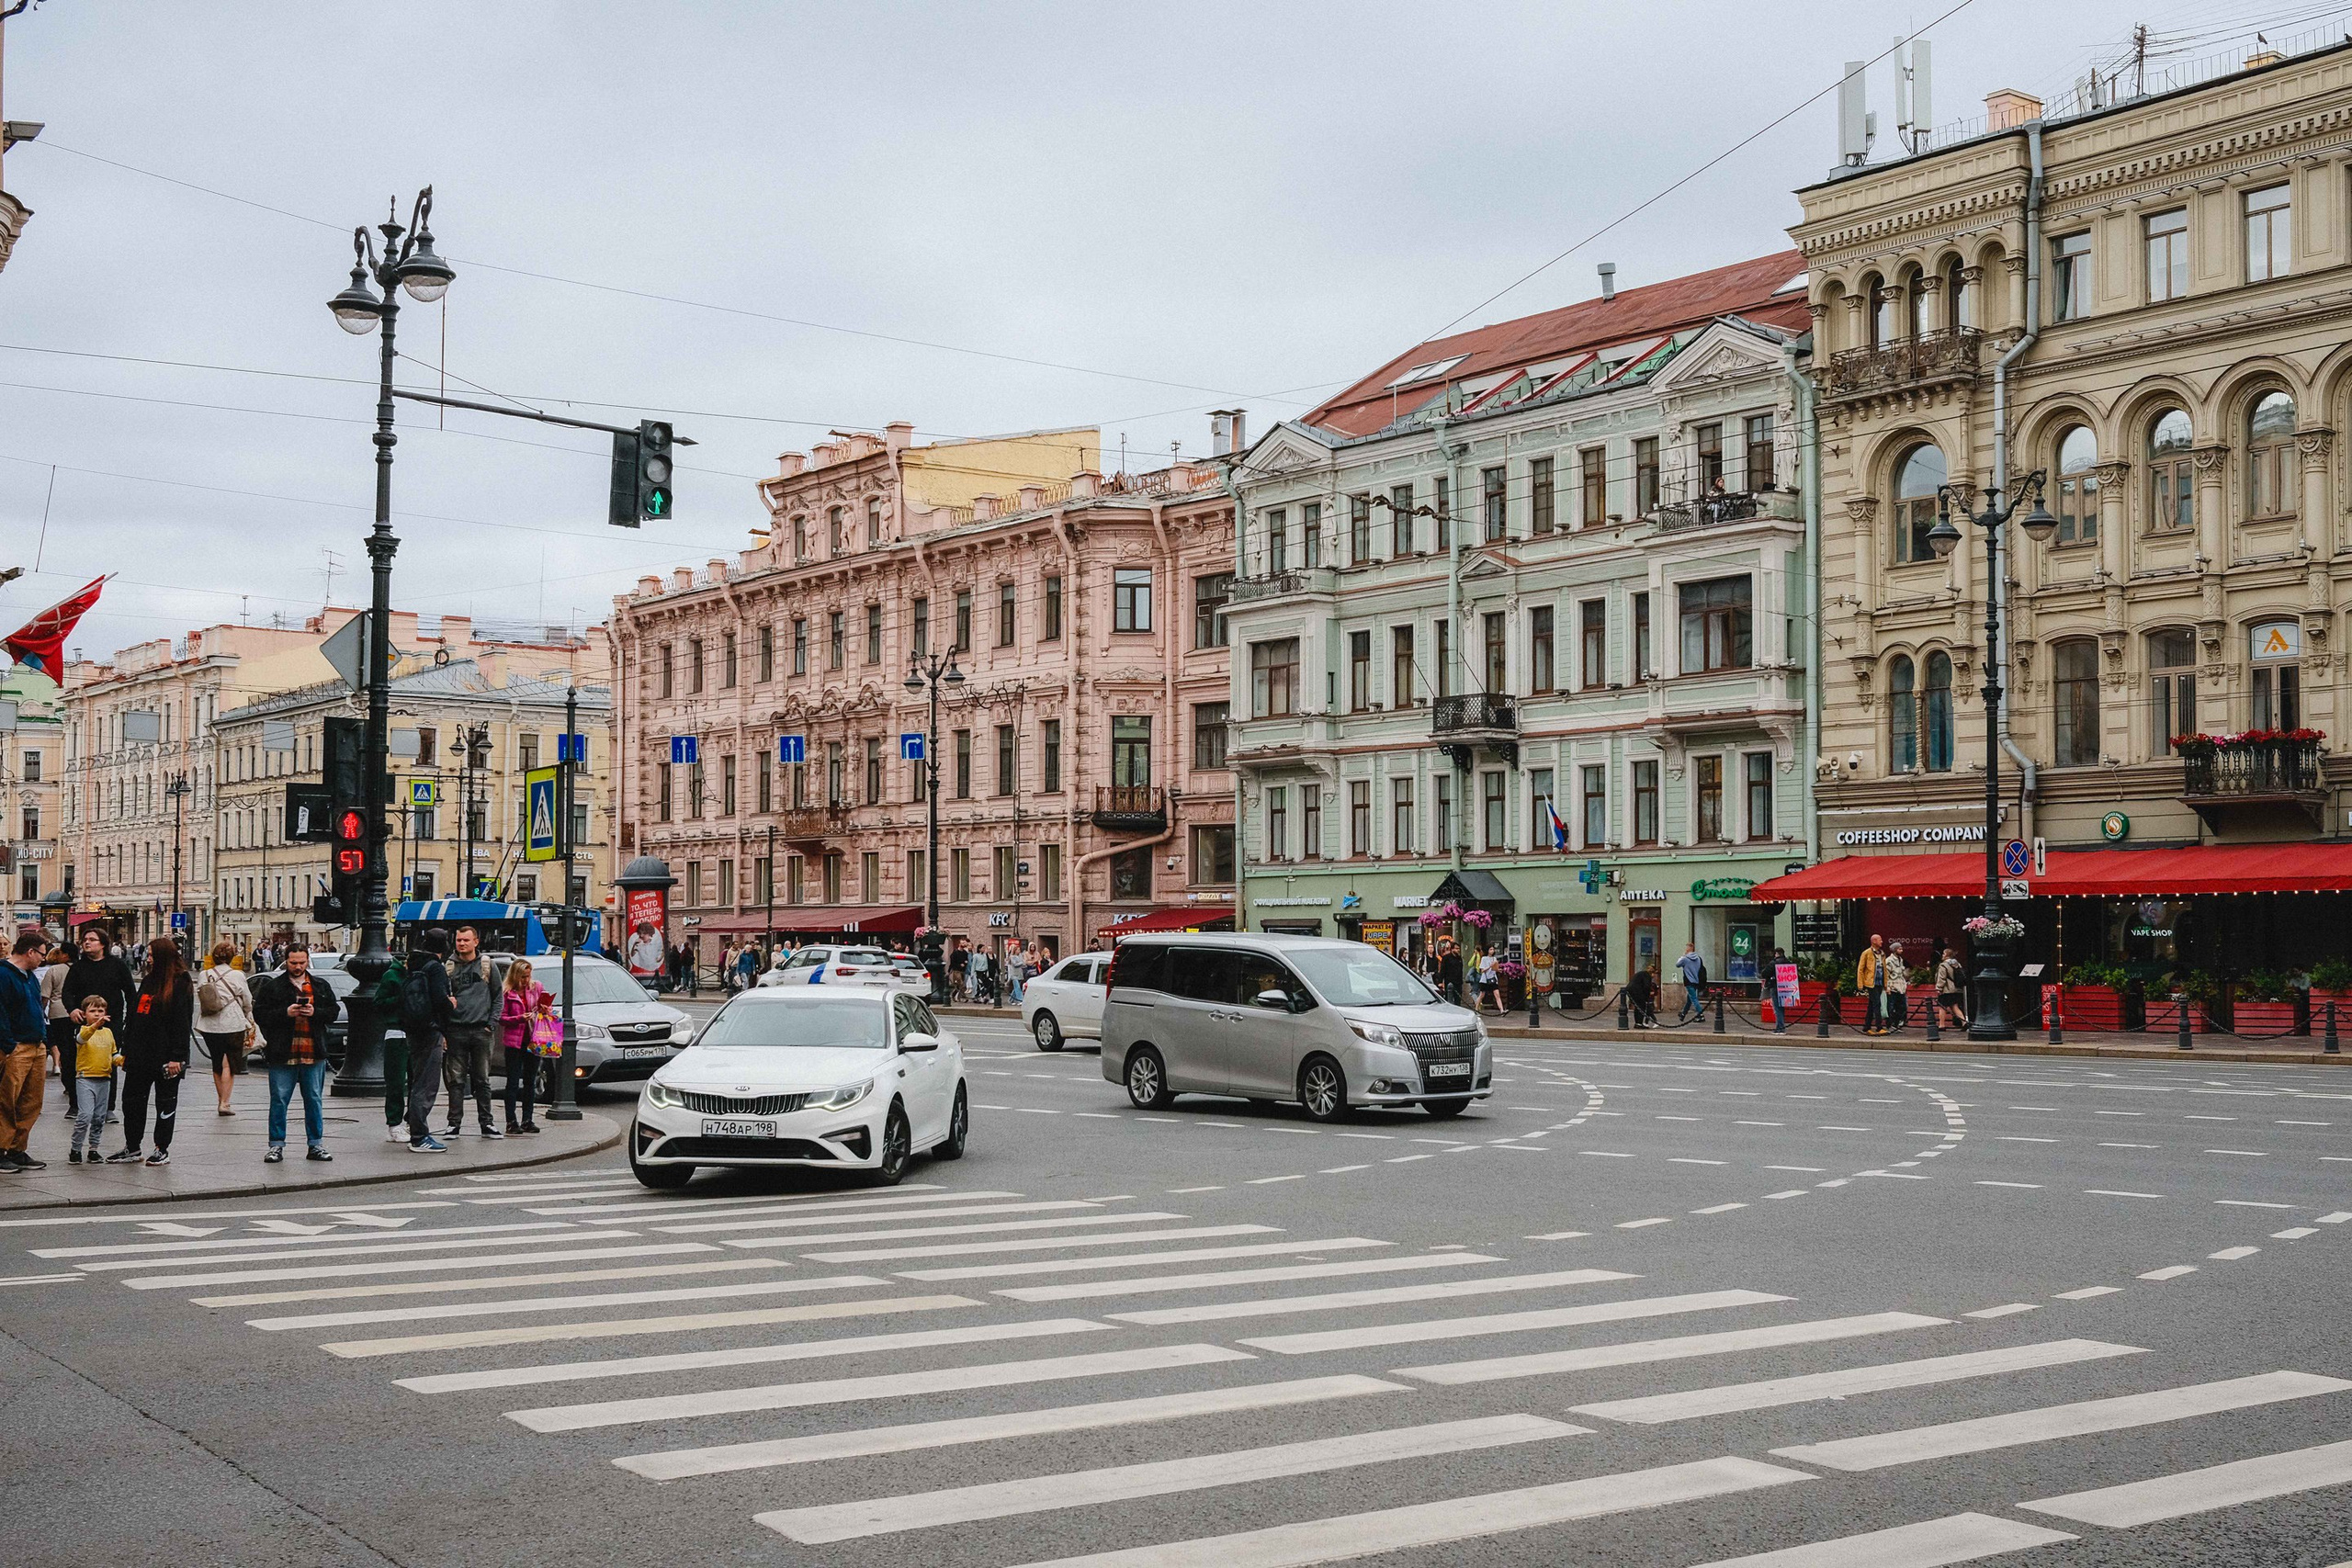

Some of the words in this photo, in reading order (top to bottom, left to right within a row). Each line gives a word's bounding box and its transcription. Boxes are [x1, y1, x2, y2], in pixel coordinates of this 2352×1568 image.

[1837, 829, 1920, 845] COFFEESHOP
[340, 850, 364, 872] 57
[1620, 890, 1667, 900] АПТЕКА
[631, 904, 642, 912] ТО,
[643, 899, 658, 908] ЧТО
[1302, 897, 1332, 906] МАГАЗИН
[1393, 897, 1429, 908] MARKET
[634, 907, 662, 918] ТЕПЕРЬ
[632, 914, 662, 926] ЛЮБЛЮ
[989, 913, 1010, 926] KFC
[1735, 937, 1749, 950] 24
[1777, 965, 1796, 974] VAPE
[754, 1122, 773, 1133] 198
